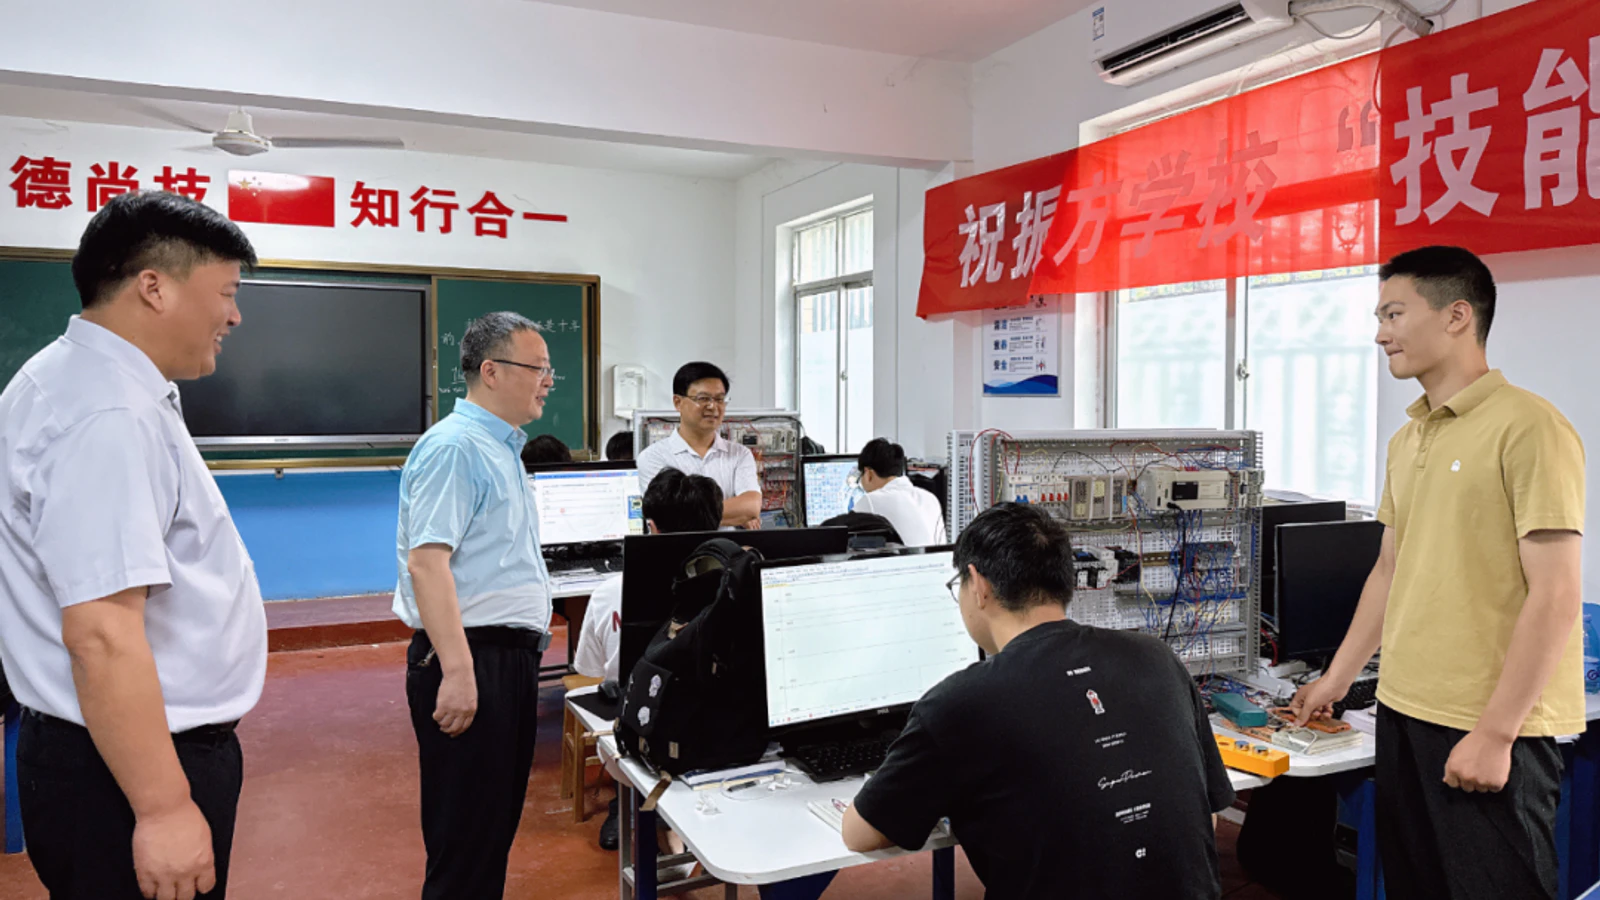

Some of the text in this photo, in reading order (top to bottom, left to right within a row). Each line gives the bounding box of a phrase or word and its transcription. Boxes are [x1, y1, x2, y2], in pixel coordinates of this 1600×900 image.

[9, 155, 211, 212] 德尚技
[350, 181, 568, 239] 知行合一
